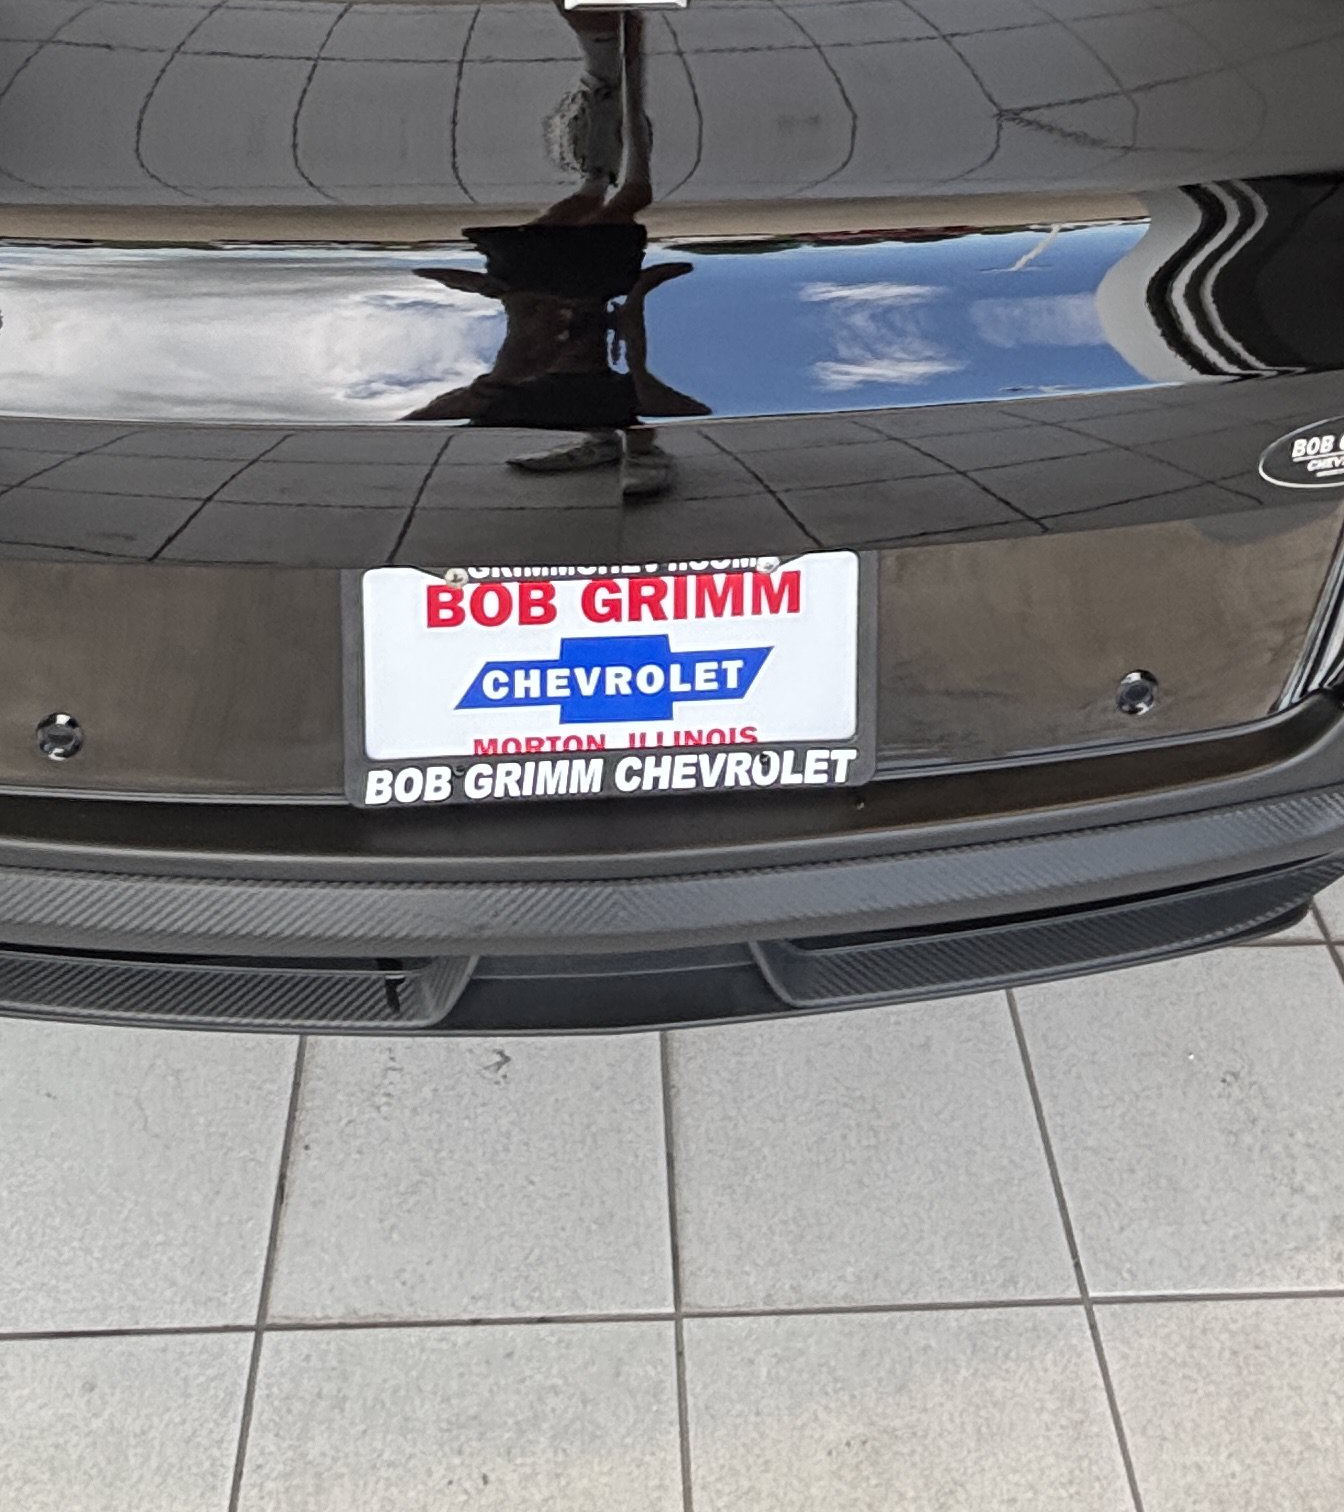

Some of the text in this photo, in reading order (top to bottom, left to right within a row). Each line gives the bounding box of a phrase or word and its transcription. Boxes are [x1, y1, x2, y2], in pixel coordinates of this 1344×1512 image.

[1292, 435, 1335, 457] BOB
[426, 570, 802, 628] BOB GRIMM
[482, 660, 745, 701] CHEVROLET
[473, 734, 606, 756] MORTON
[365, 749, 857, 805] BOB GRIMM CHEVROLET
